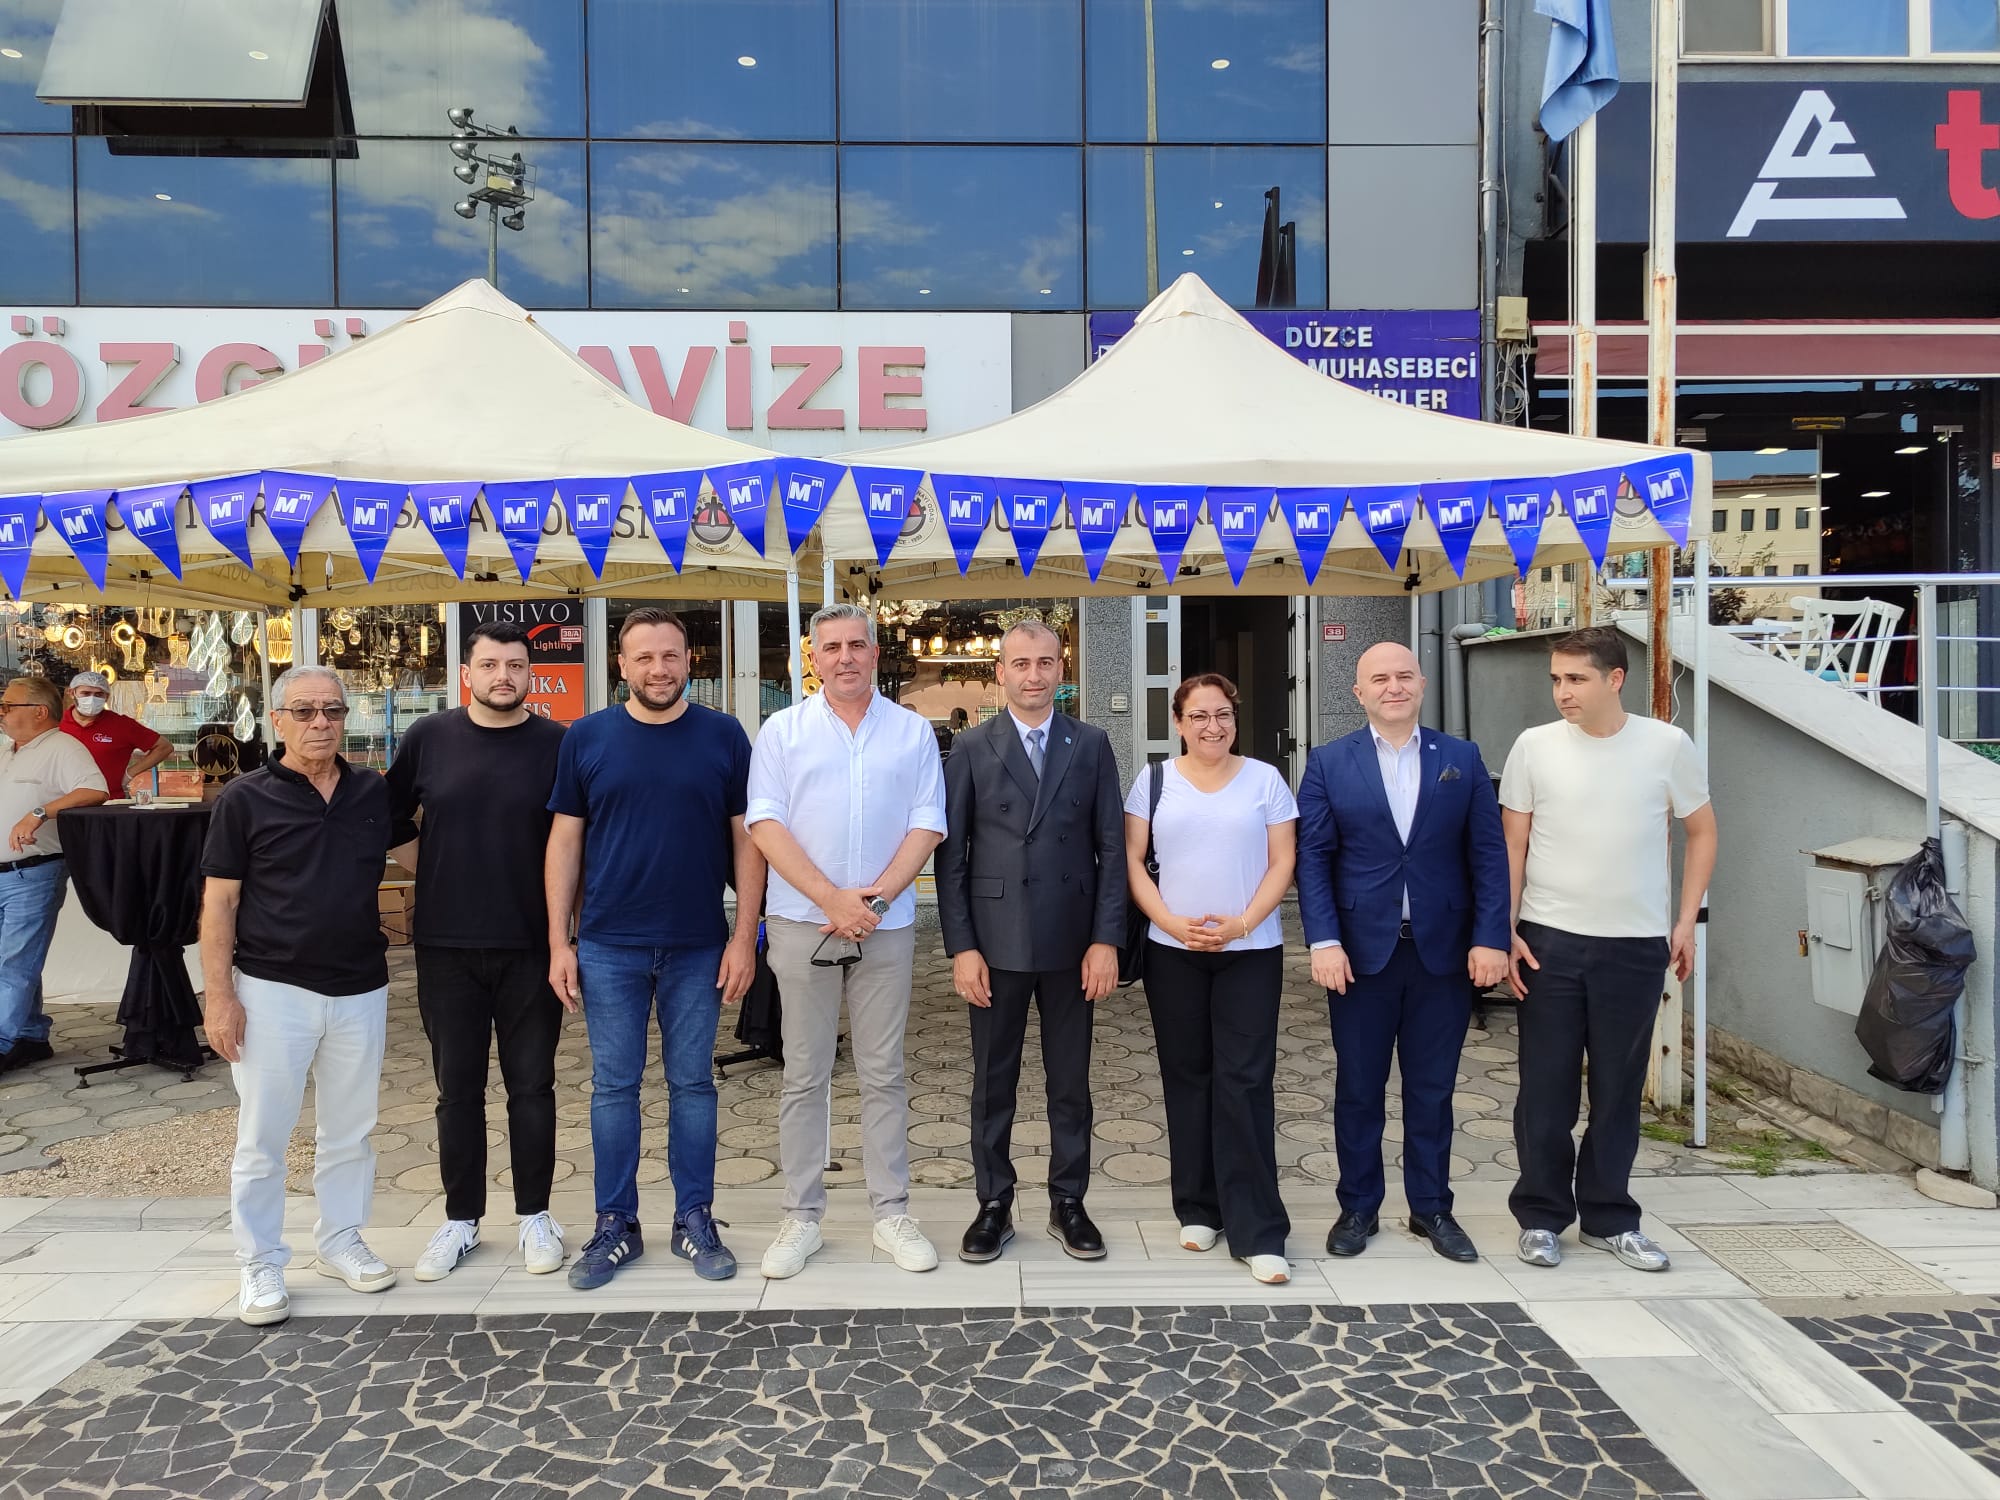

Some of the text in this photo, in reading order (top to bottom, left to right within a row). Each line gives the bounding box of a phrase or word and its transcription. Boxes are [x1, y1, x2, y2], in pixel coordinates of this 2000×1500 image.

[1285, 321, 1373, 347] DÜZCE
[1307, 352, 1476, 379] MUHASEBECİ
[1366, 383, 1448, 409] İRLER
[533, 640, 572, 651] Lighting
[528, 672, 568, 694] İKA
